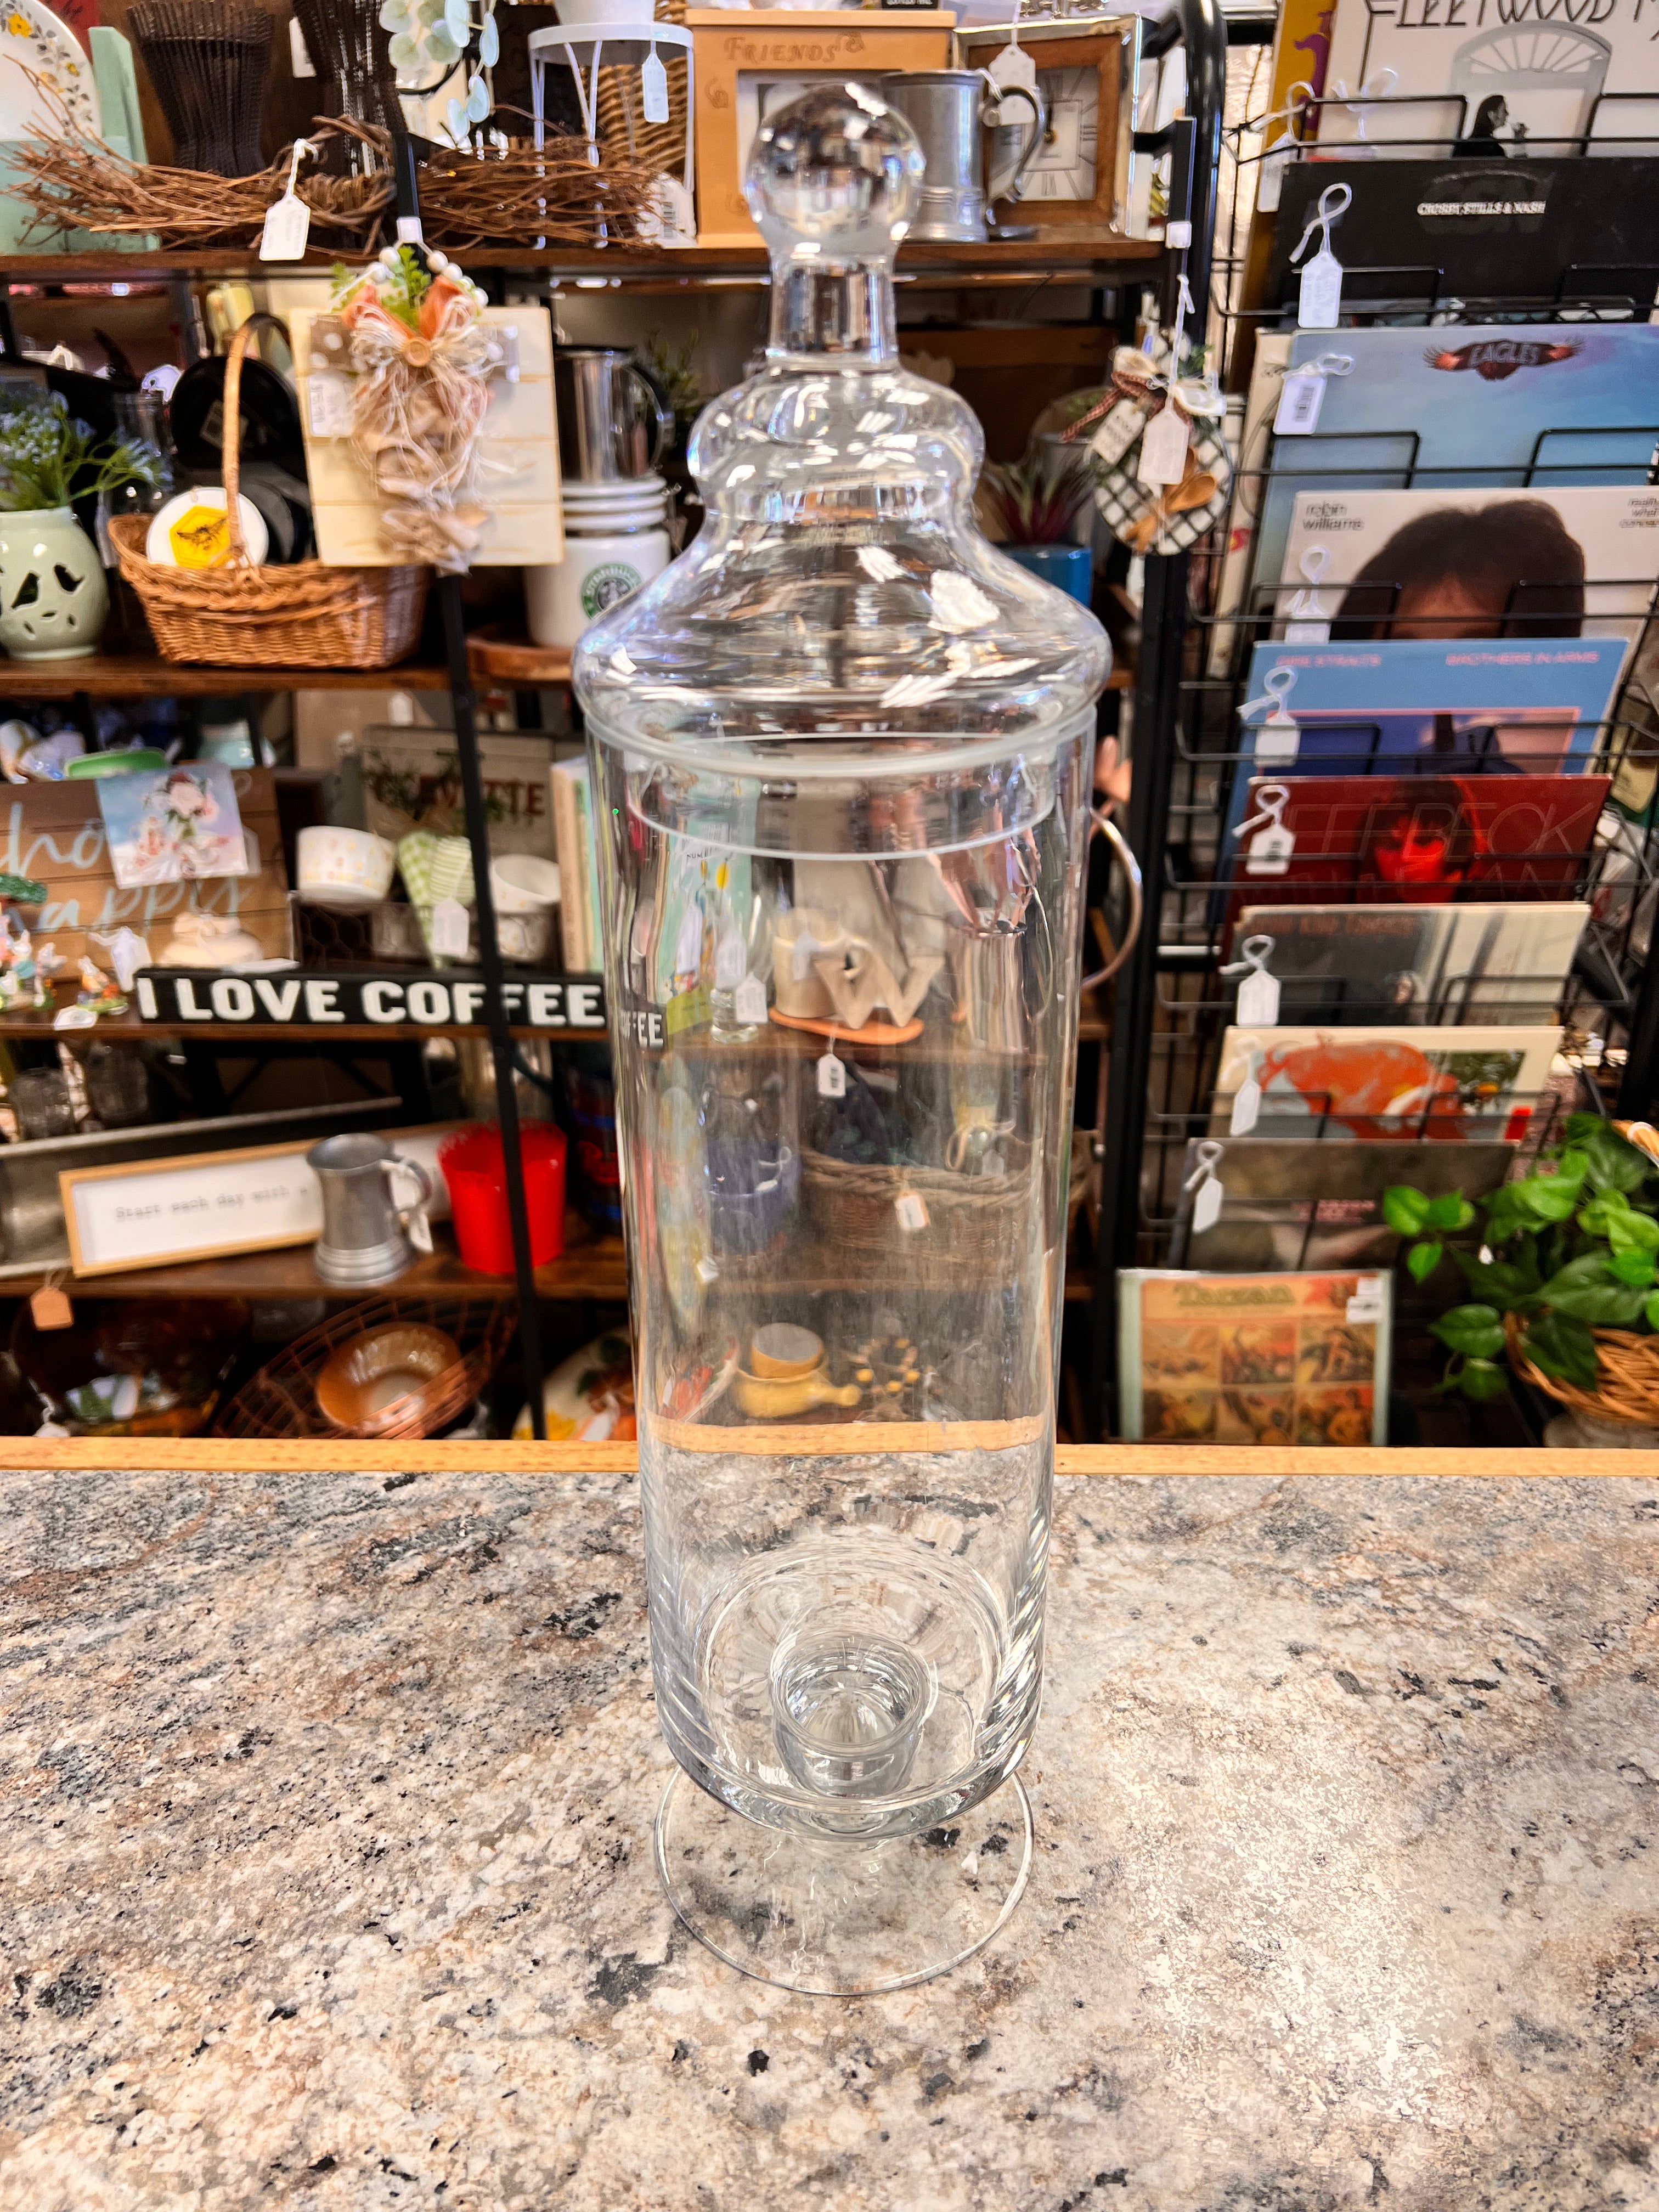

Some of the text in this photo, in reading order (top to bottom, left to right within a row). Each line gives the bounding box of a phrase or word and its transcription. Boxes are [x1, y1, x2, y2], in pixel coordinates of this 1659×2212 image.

[723, 36, 838, 64] FRIENDS
[1468, 340, 1541, 369] EAGLES
[137, 977, 159, 1020] I
[173, 977, 346, 1023] LOVE
